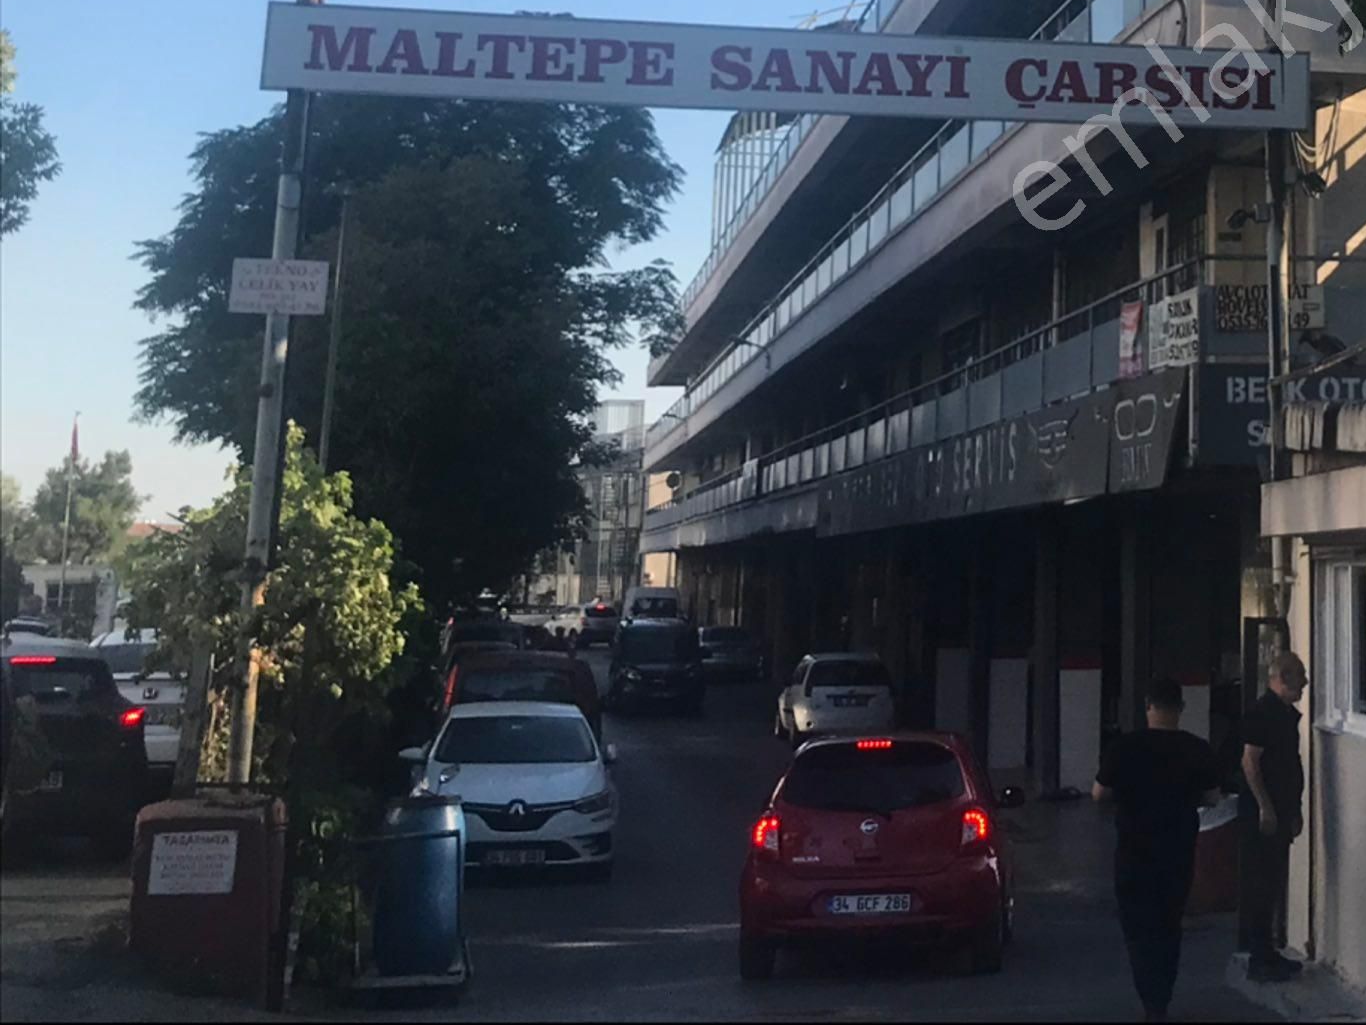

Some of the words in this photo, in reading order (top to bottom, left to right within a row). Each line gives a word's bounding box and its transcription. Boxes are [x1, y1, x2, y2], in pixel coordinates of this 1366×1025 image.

[305, 23, 674, 88] MALTEPE
[1004, 57, 1277, 114] ÇARŞISI
[832, 897, 849, 912] 34
[856, 896, 880, 911] GCF
[885, 895, 909, 910] 286
